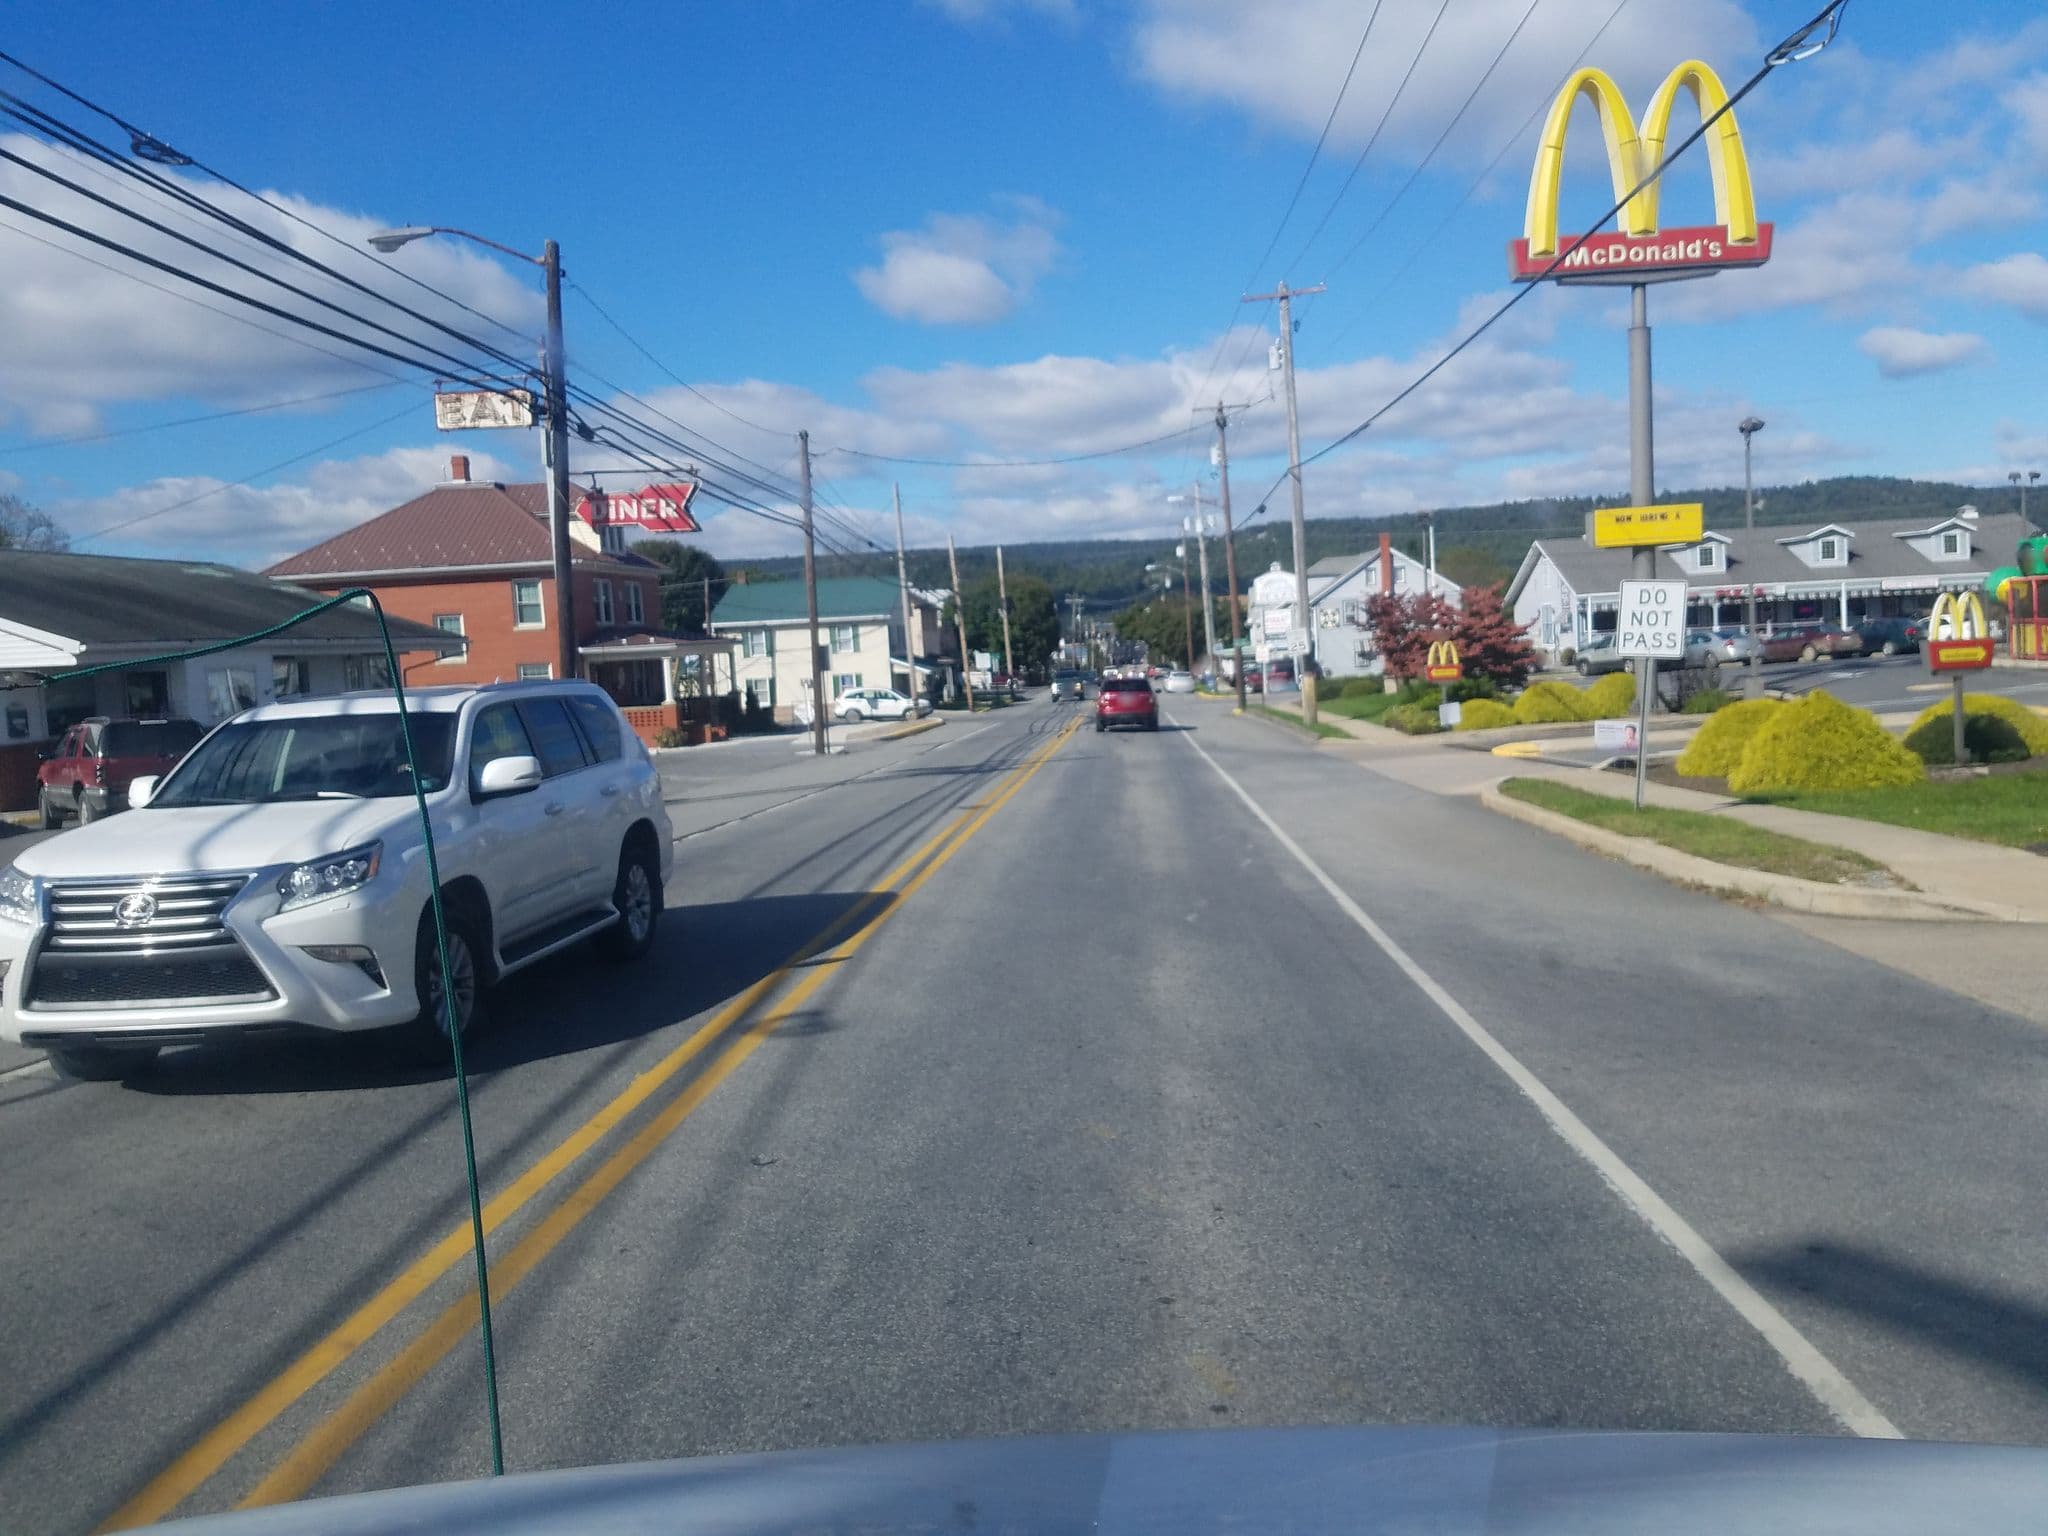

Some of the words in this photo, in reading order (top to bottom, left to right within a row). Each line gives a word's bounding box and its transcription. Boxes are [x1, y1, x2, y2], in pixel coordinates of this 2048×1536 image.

[1563, 238, 1723, 268] McDonald's
[439, 394, 525, 425] EAT
[591, 498, 679, 520] DINER
[1639, 588, 1668, 605] DO
[1630, 610, 1673, 627] NOT
[1622, 632, 1677, 649] PASS
